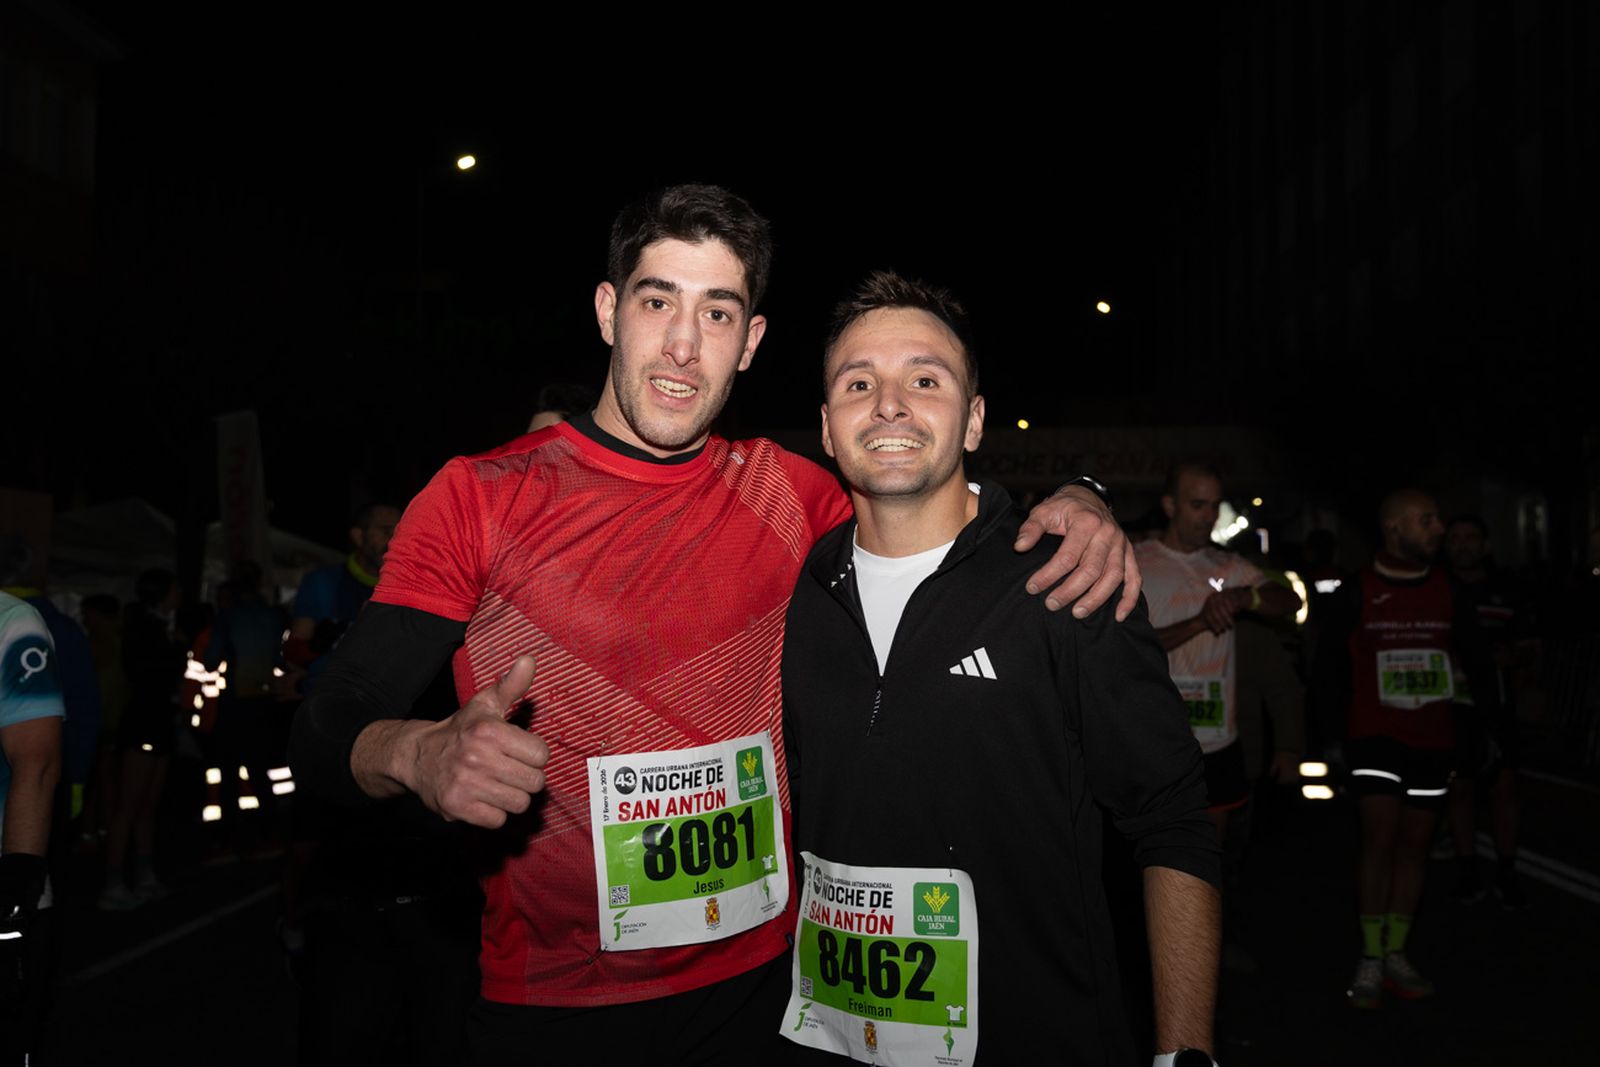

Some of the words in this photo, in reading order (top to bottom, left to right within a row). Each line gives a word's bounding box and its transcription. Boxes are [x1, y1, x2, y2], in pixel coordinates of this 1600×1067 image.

[615, 772, 636, 787] 43
[640, 766, 665, 774] CARRERA
[666, 763, 689, 772] URBANA
[642, 770, 702, 794] NOCHE
[706, 765, 724, 785] DE
[618, 798, 660, 822] SAN
[665, 785, 726, 817] ANTÓN
[642, 806, 755, 882] 8081
[693, 878, 725, 895] Jesus
[822, 882, 865, 907] NOCHE
[869, 890, 893, 909] DE
[809, 900, 831, 926] SAN
[833, 909, 894, 935] ANTÓN
[818, 929, 936, 1002] 8462
[848, 997, 893, 1018] Freiman
